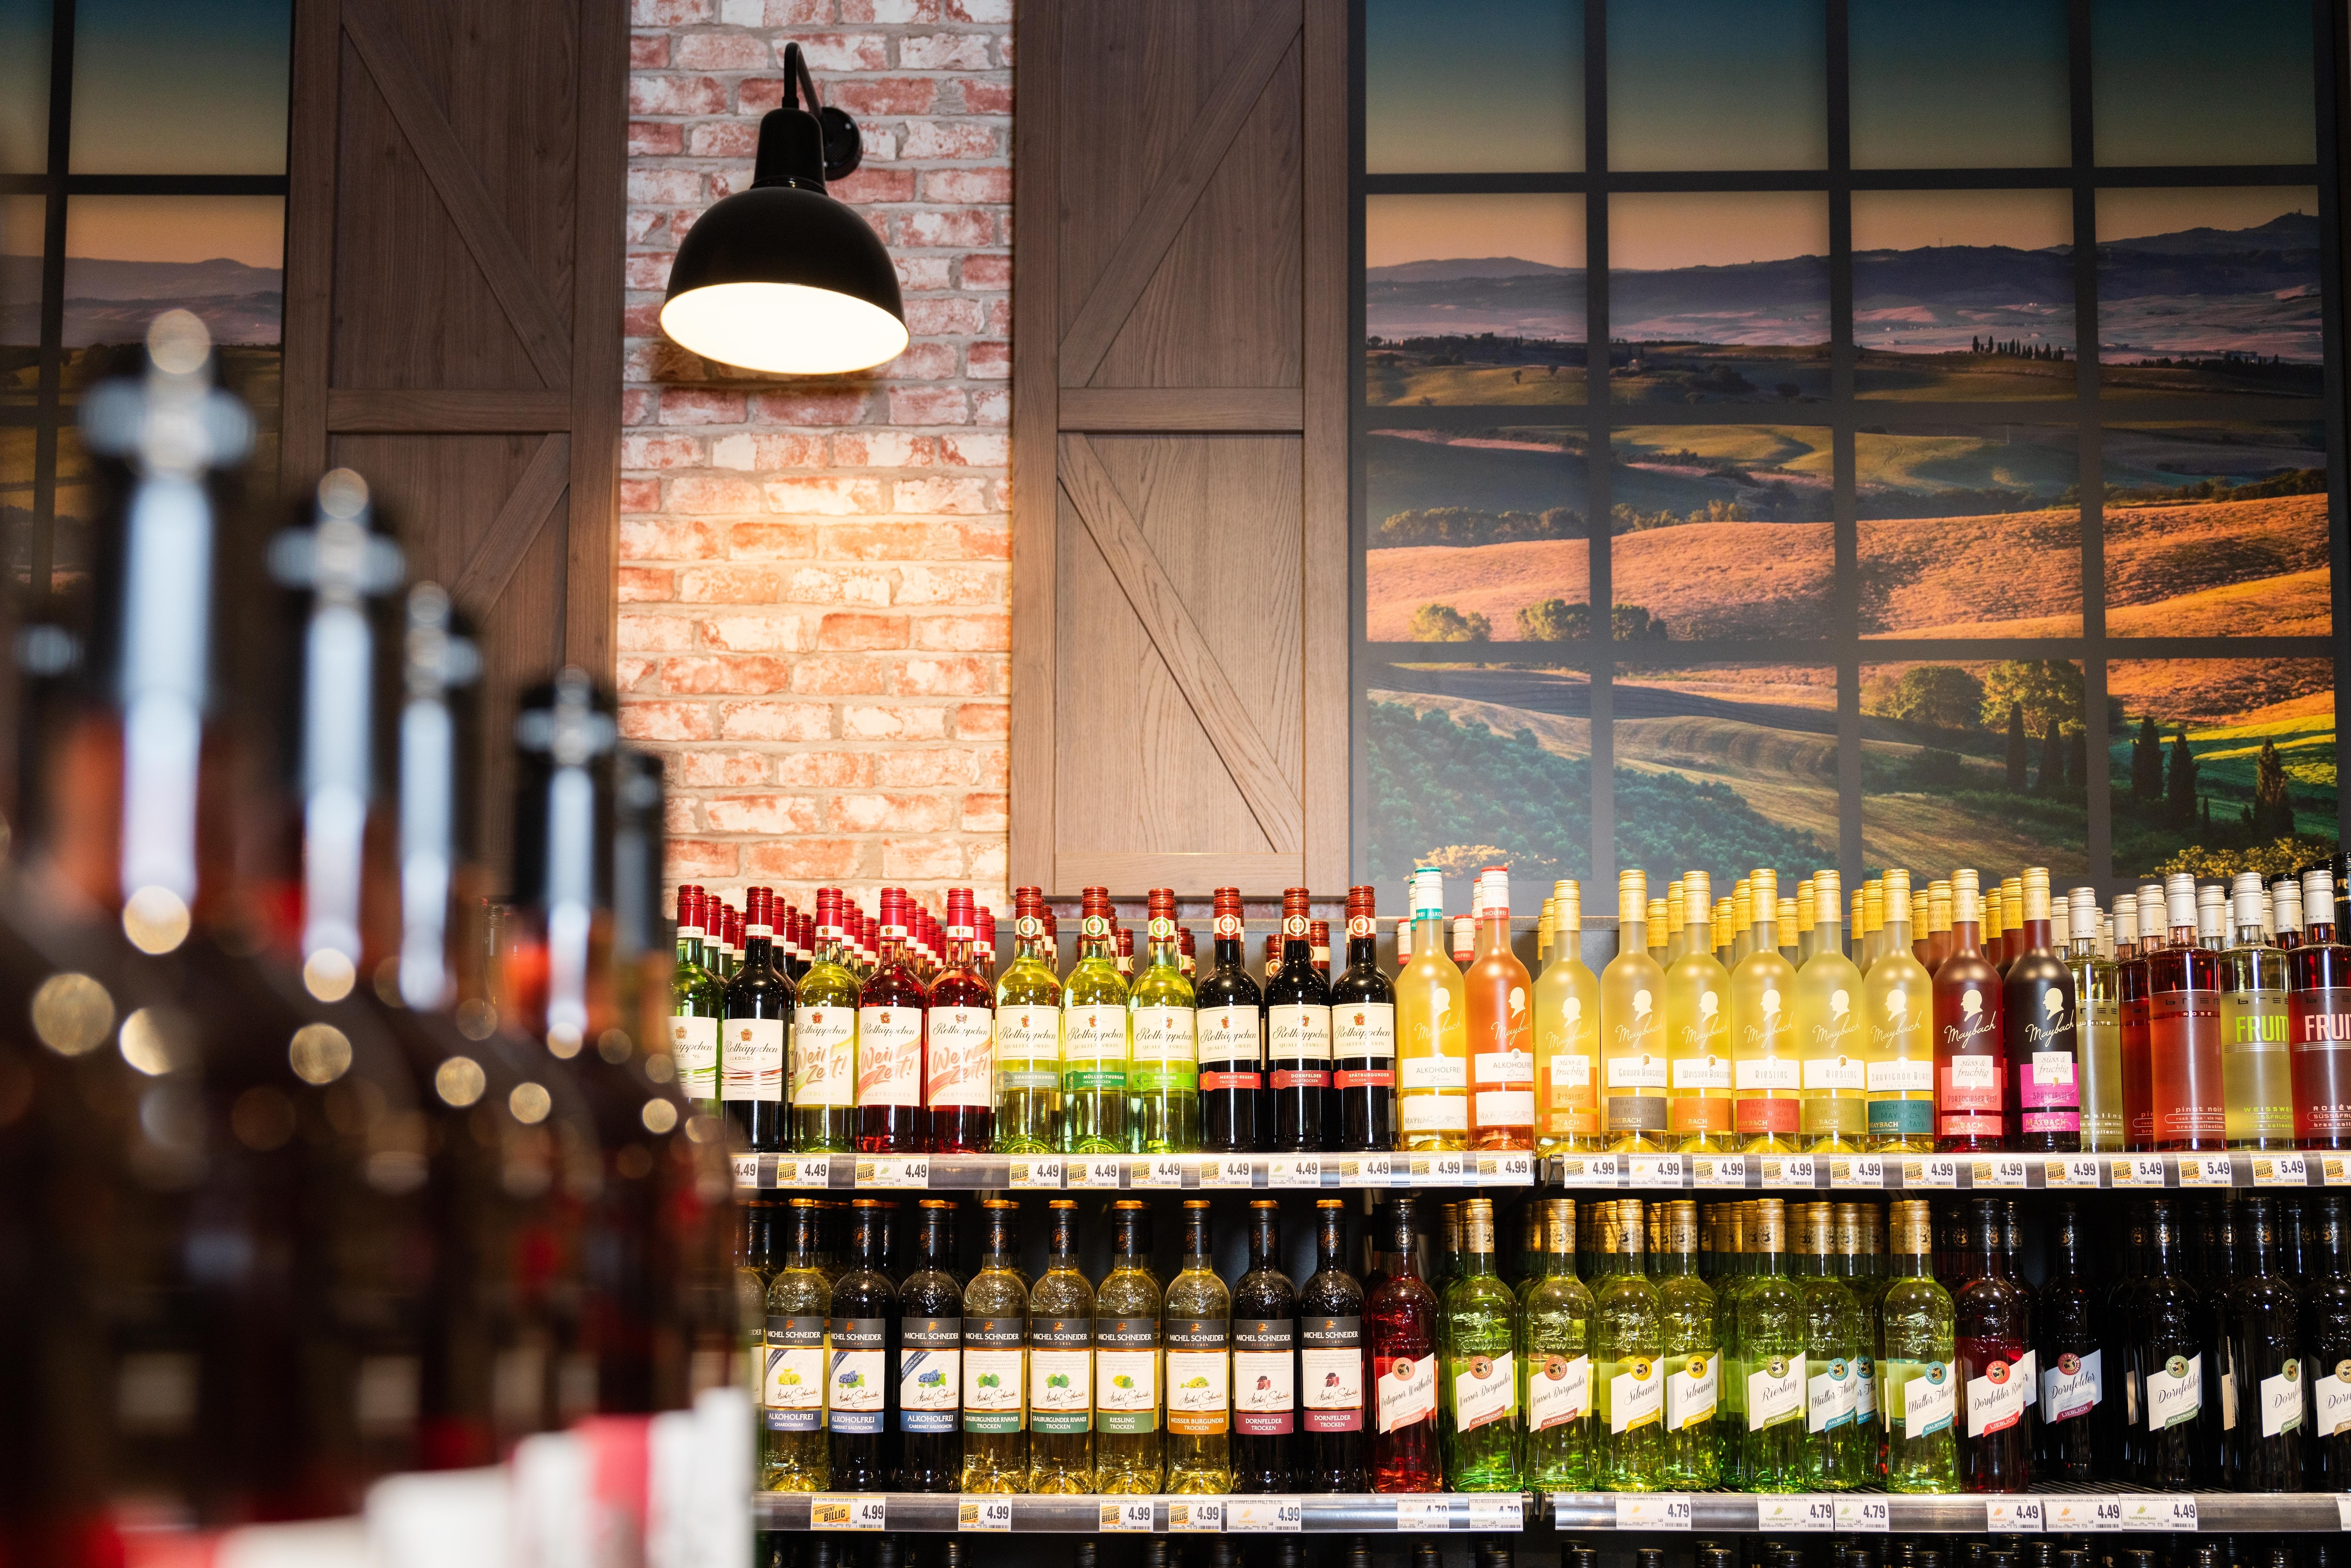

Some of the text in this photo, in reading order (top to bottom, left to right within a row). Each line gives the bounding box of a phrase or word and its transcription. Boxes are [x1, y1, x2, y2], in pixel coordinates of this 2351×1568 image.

[796, 1023, 847, 1037] Rotkäppchen
[862, 1023, 915, 1036] Rotkäppchen
[1067, 1027, 1123, 1041] Rotkäppchen
[1335, 1025, 1390, 1040] Rotkäppchen
[1615, 1012, 1663, 1048] Maybach
[1744, 1011, 1793, 1048] Maybach
[1813, 1012, 1861, 1048] Maybach
[1870, 1010, 1922, 1048] Maybach
[1944, 1011, 1996, 1048] Maybach
[2025, 1009, 2074, 1047] Maybach
[2304, 1014, 2351, 1041] FRUI
[1200, 1029, 1256, 1043] Rotkäppchen
[723, 1041, 778, 1054] Rotkäppchen
[873, 1055, 914, 1084] Zeit!
[949, 1055, 987, 1085] Zeit!
[1555, 1067, 1585, 1077] fruchtig
[1957, 1067, 1989, 1079] fruchtig
[2039, 1064, 2068, 1074] fruchtig
[735, 1164, 756, 1176] 4.49
[805, 1164, 826, 1176] 4.49
[906, 1165, 926, 1178] 4.49
[1037, 1165, 1058, 1177] 4.49
[1095, 1165, 1117, 1177] 4.49
[1159, 1163, 1180, 1175] 4.49
[1227, 1163, 1249, 1175] 4.49
[1296, 1163, 1318, 1175] 4.49
[1367, 1162, 1389, 1174] 4.49
[1438, 1161, 1460, 1174] 4.99
[1506, 1161, 1527, 1174] 4.99
[1593, 1162, 1614, 1175] 4.99
[1658, 1163, 1679, 1175] 4.99
[1722, 1163, 1743, 1176] 4.99
[1791, 1163, 1812, 1176] 4.99
[1859, 1163, 1880, 1176] 4.99
[1931, 1163, 1953, 1176] 4.99
[2001, 1164, 2022, 1176] 4.99
[2074, 1163, 2096, 1176] 4.99
[2140, 1162, 2162, 1175] 5.49
[2208, 1162, 2230, 1175] 5.49
[2256, 1167, 2273, 1177] BILLIG
[2281, 1161, 2304, 1174] 5.49
[779, 1170, 796, 1179] BILLIG
[1459, 1373, 1510, 1407] Weisser Burgunder
[1680, 1378, 1714, 1403] Silvaner
[1761, 1378, 1797, 1403] Riesling
[2051, 1370, 2096, 1399] Dornfelder
[2157, 1373, 2200, 1404] Dornfelder
[1381, 1374, 1433, 1409] Portugieser Weißherbst
[1624, 1380, 1659, 1405] Silvaner
[1973, 1387, 2010, 1410] Dornfelder
[1472, 1410, 1503, 1426] HALBTROCKEN
[1688, 1410, 1712, 1423] TROCKEN
[1766, 1410, 1797, 1425] HALBTROCKEN
[1828, 1411, 1855, 1426] HALBTROCKEN
[2061, 1406, 2088, 1418] LIEBLICH
[2168, 1409, 2198, 1423] HALBTROCKEN
[1396, 1412, 1421, 1426] LIEBLICH
[1632, 1413, 1657, 1426] TROCKEN
[1925, 1416, 1952, 1431] HALBTROCKEN
[1989, 1417, 2015, 1429] LIEBLICH
[814, 1506, 835, 1515] DISCOUNT
[824, 1509, 845, 1522] BILLIG
[862, 1505, 884, 1519] 4.99
[987, 1506, 1009, 1519] 4.99
[1128, 1507, 1150, 1520] 4.99
[1197, 1507, 1219, 1520] 4.99
[1278, 1507, 1300, 1521] 4.99
[1668, 1504, 1689, 1518] 4.79
[1810, 1505, 1831, 1518] 4.79
[1863, 1505, 1885, 1518] 4.79
[2017, 1505, 2038, 1519] 4.49
[2098, 1505, 2120, 1519] 4.49
[2174, 1504, 2195, 1518] 4.49
